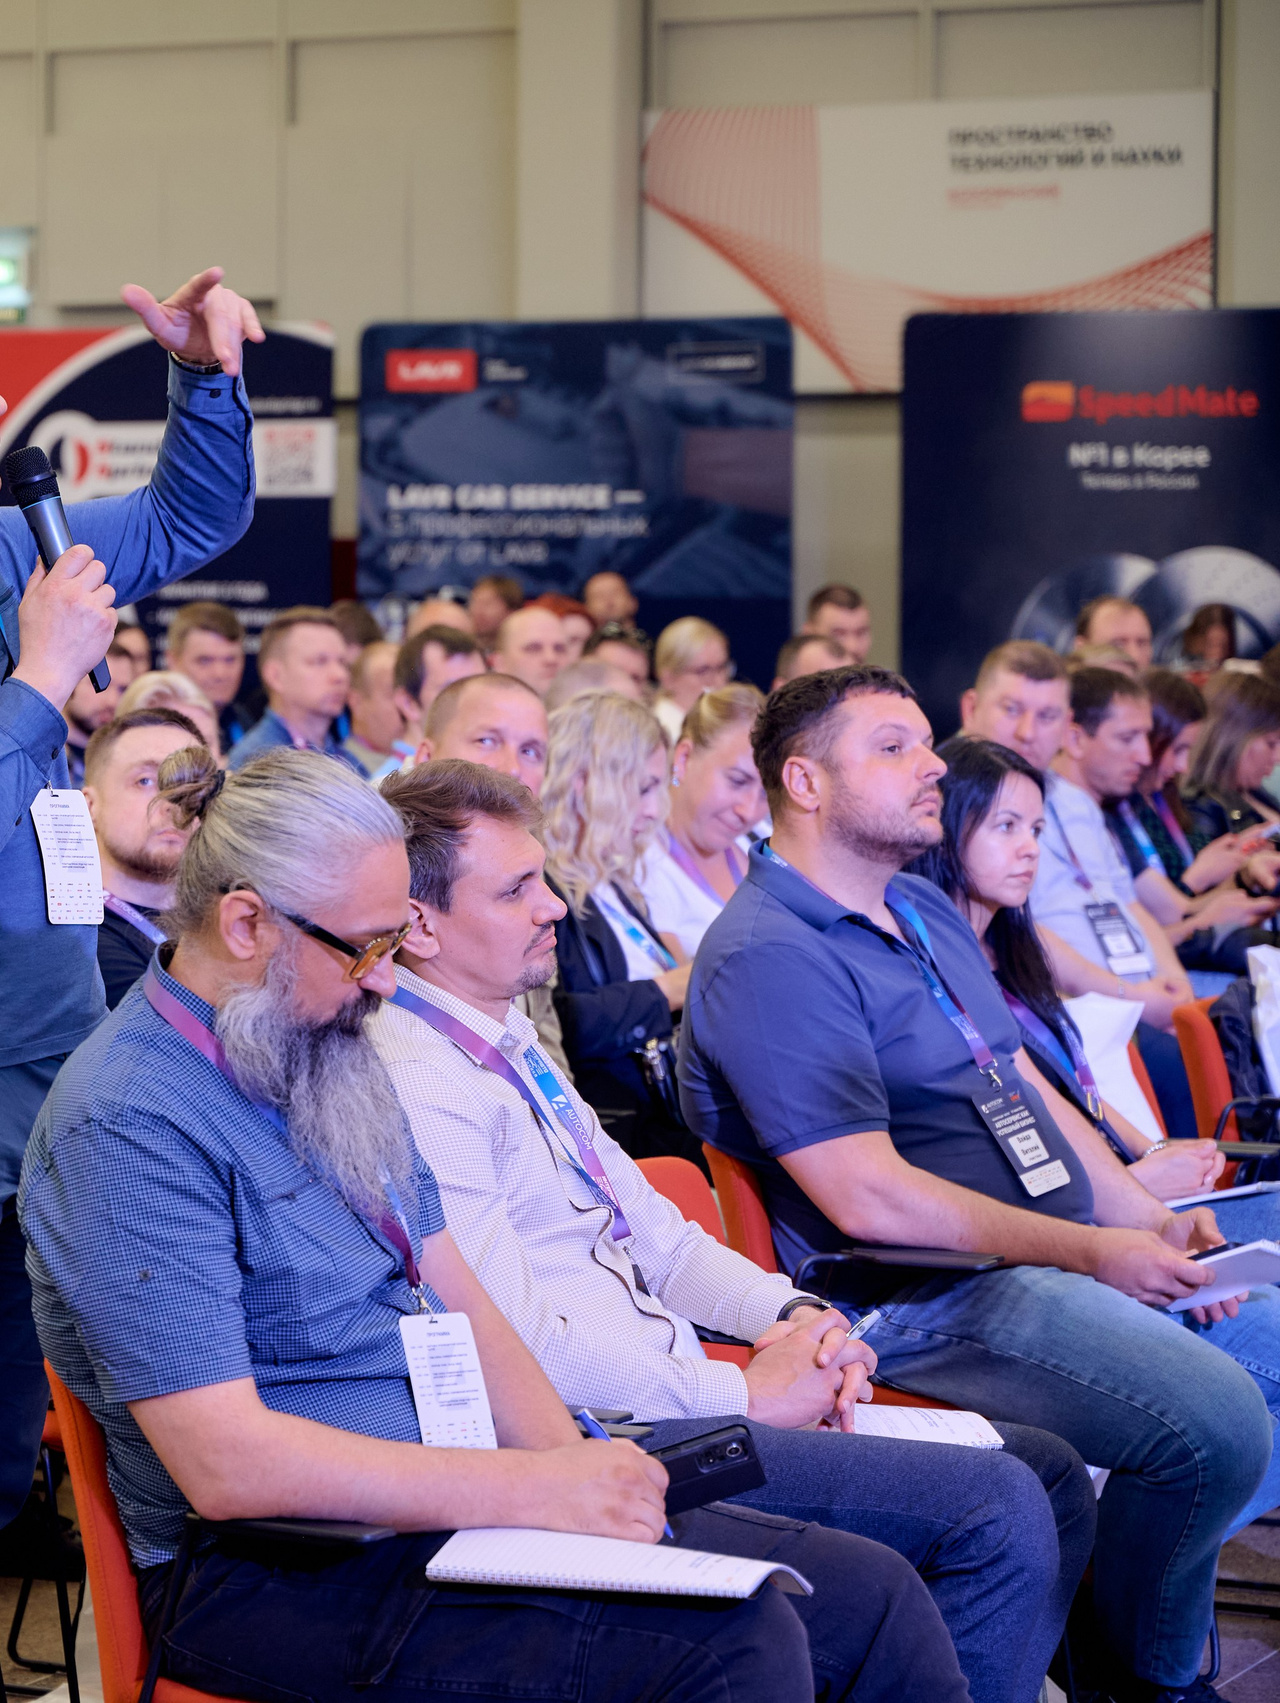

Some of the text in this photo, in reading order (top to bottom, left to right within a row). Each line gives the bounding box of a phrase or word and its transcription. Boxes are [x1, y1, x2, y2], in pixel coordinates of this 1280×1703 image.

[1077, 384, 1260, 425] SpeedMate
[1133, 441, 1211, 472] Корее
[565, 1109, 593, 1150] AUTOCOM
